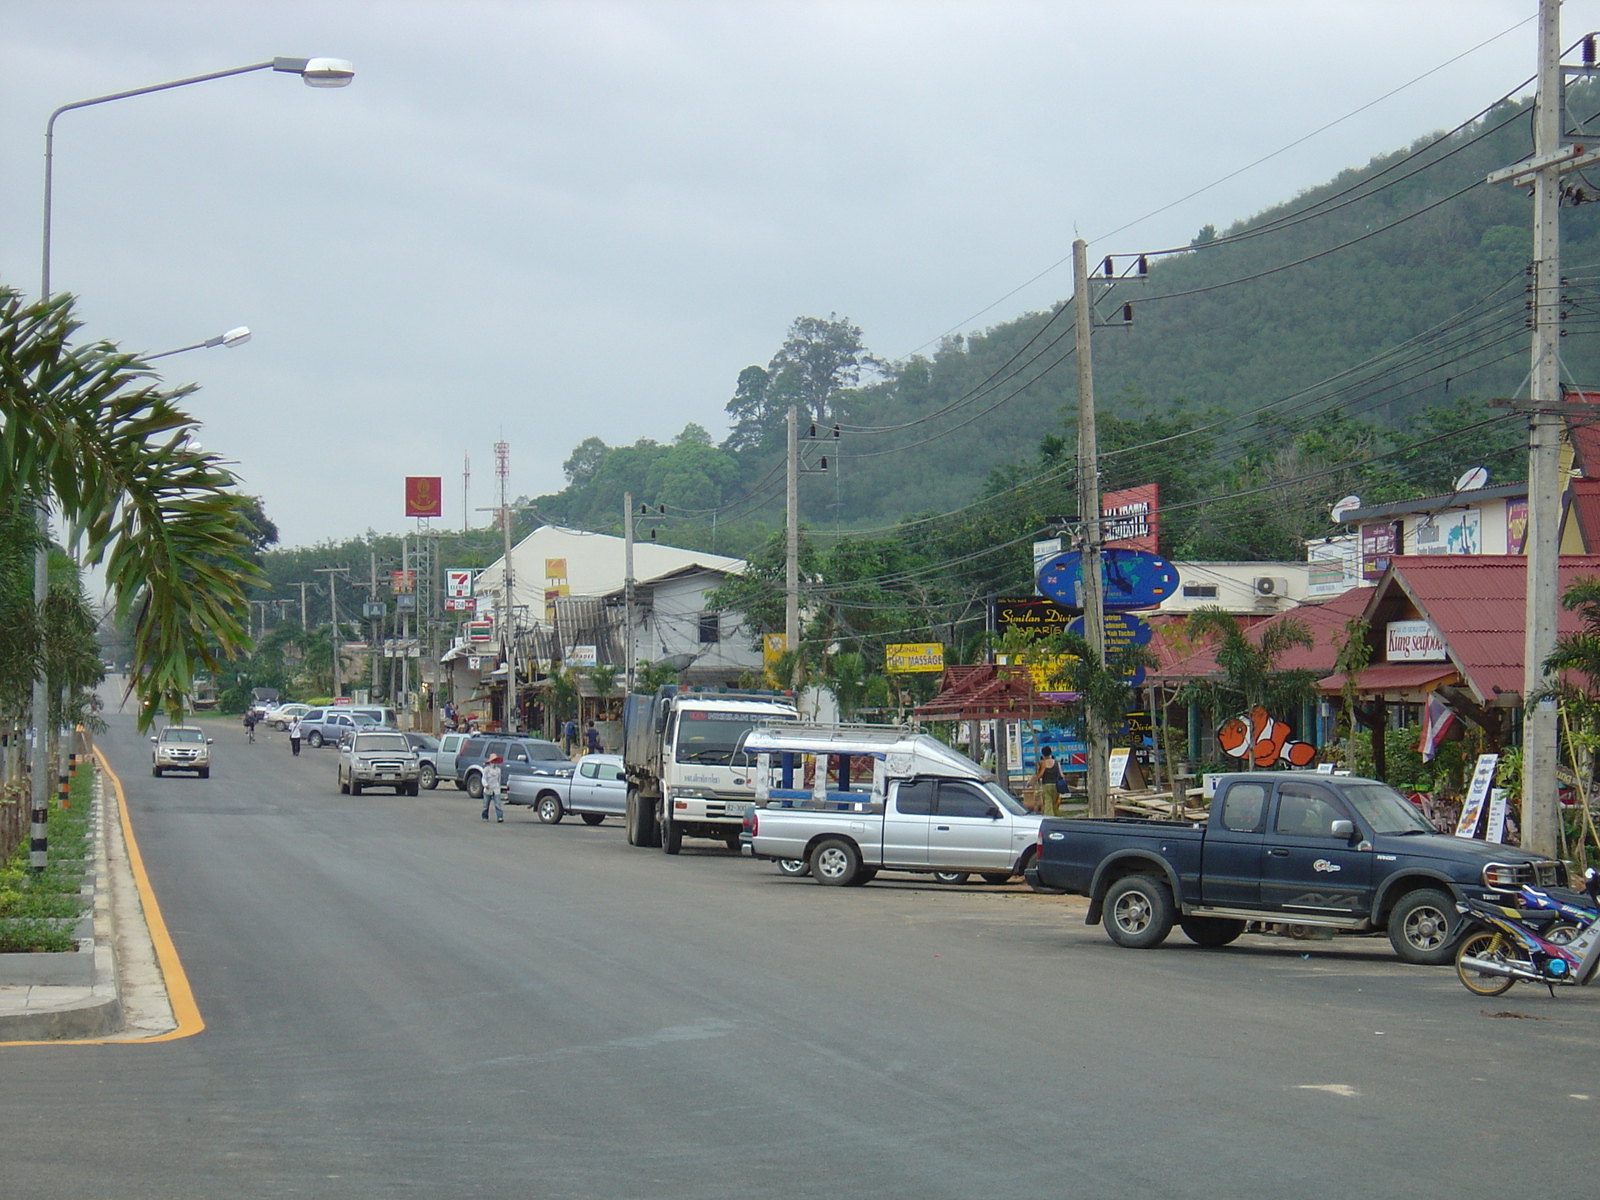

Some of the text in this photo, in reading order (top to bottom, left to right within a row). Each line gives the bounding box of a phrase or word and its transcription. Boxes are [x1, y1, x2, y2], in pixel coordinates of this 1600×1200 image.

[998, 608, 1075, 625] Similan Divi
[1388, 629, 1411, 658] Kung
[888, 655, 942, 666] THAI MASSAGE
[707, 713, 748, 721] NISSAN
